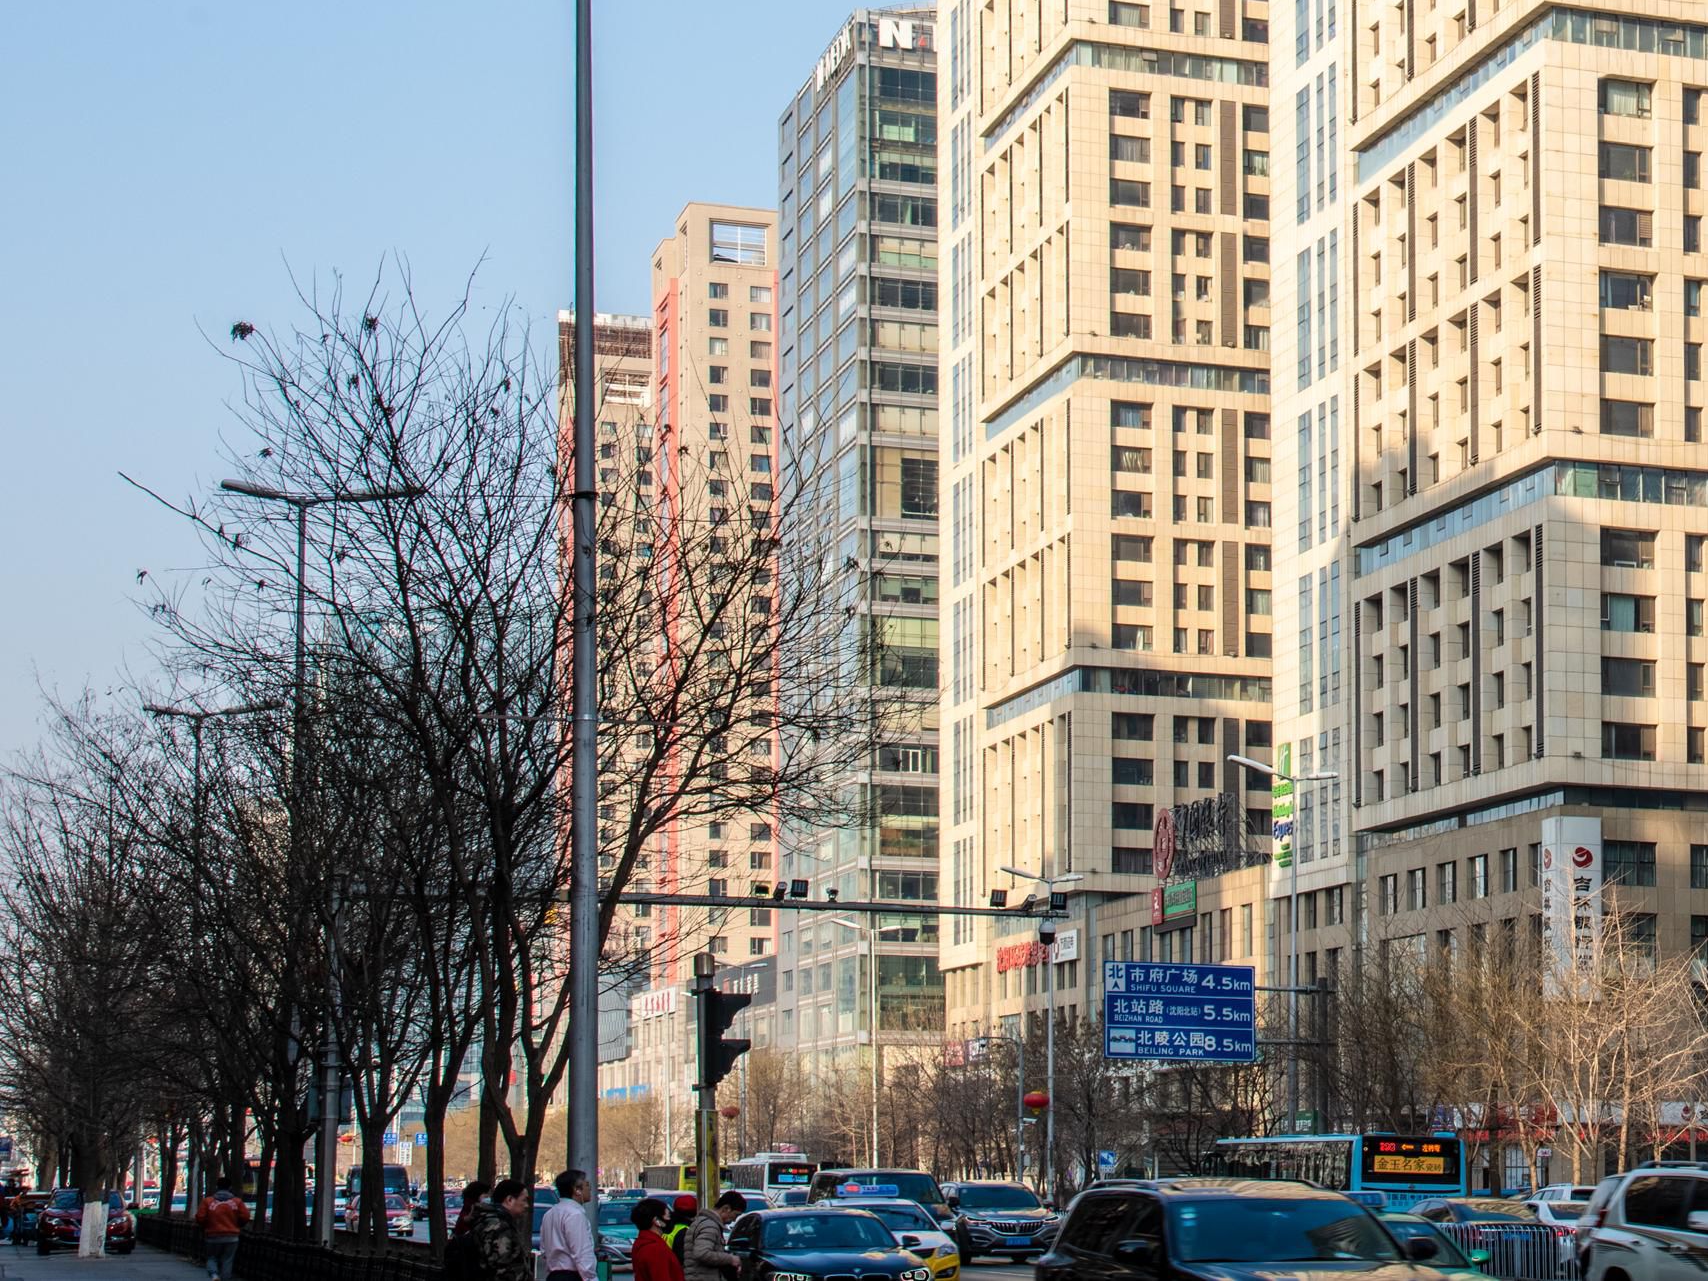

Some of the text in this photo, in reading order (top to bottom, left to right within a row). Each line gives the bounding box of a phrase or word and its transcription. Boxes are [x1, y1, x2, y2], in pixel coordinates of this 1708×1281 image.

[1108, 964, 1124, 979] 北
[1130, 967, 1250, 991] 市府广场 4.5km
[1130, 983, 1196, 993] SHIFU SQUARE
[1113, 999, 1164, 1015] 北站路
[1203, 1005, 1251, 1022] 5.5km
[1114, 1014, 1163, 1023] BEIZHAN ROAD
[1137, 1030, 1252, 1053] 北陵公园 8.5km
[1137, 1047, 1204, 1056] BEILING PARK
